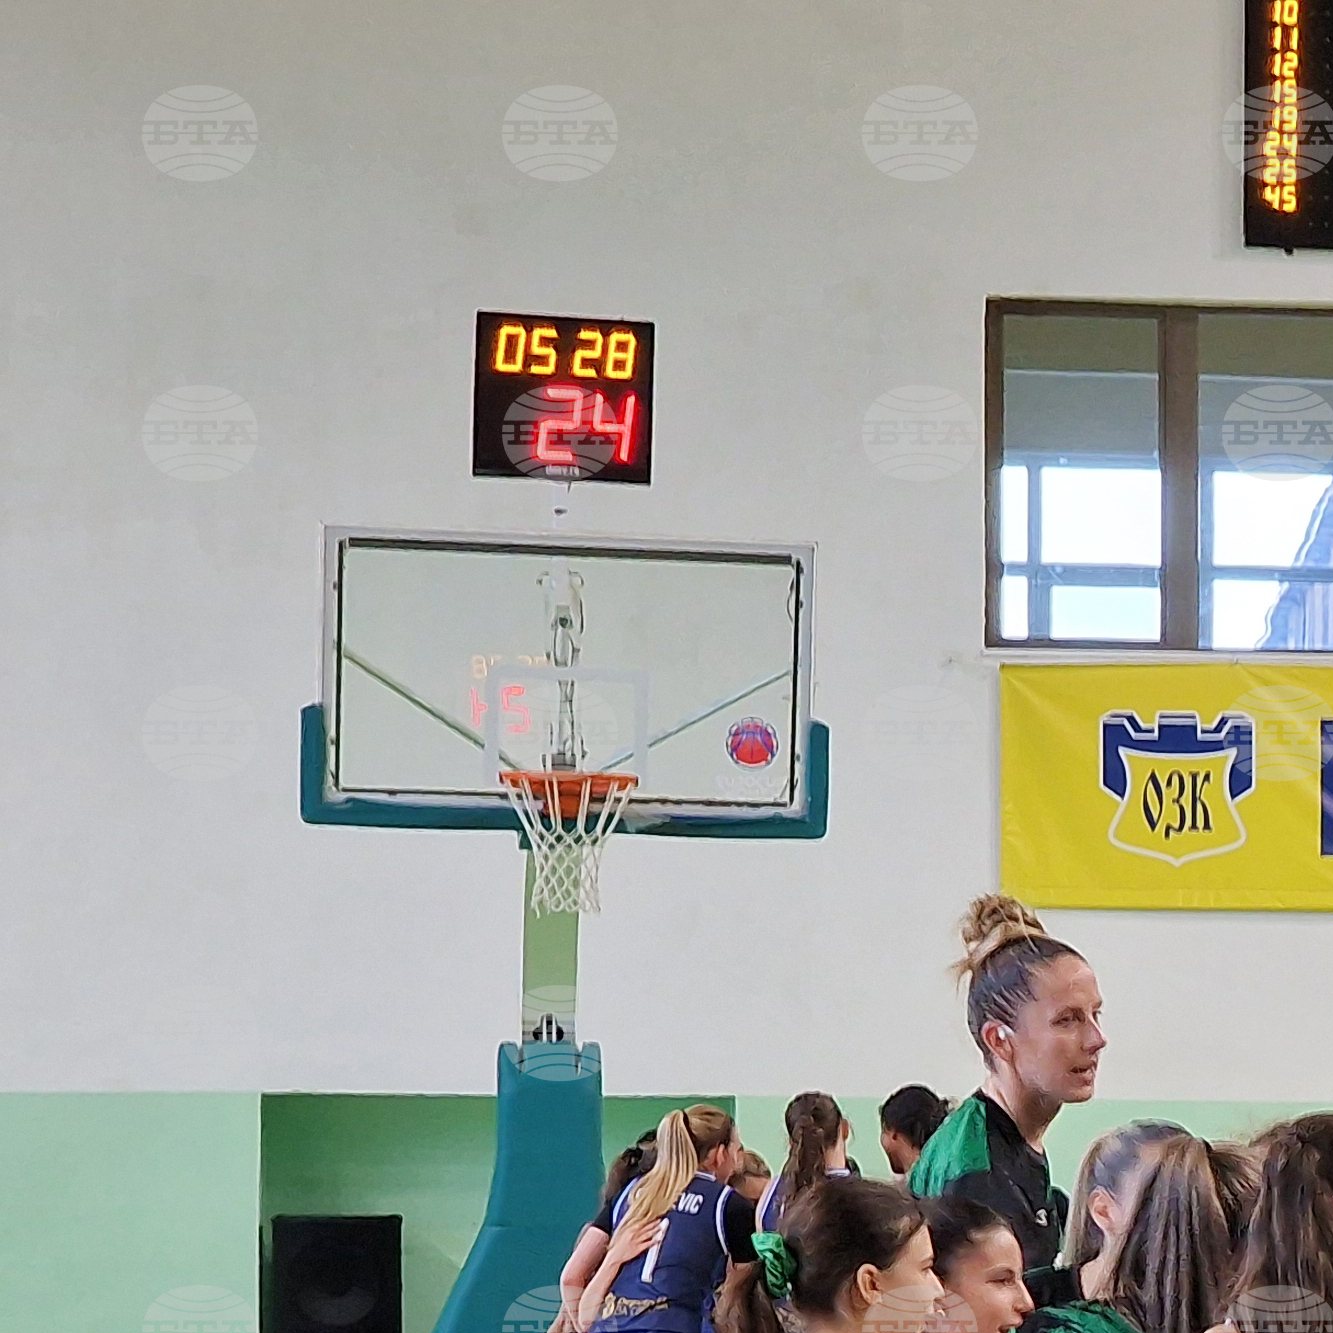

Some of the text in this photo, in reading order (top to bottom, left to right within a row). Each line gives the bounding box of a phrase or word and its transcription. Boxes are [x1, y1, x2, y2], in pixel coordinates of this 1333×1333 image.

[494, 323, 638, 380] 05 28
[535, 387, 638, 463] 24
